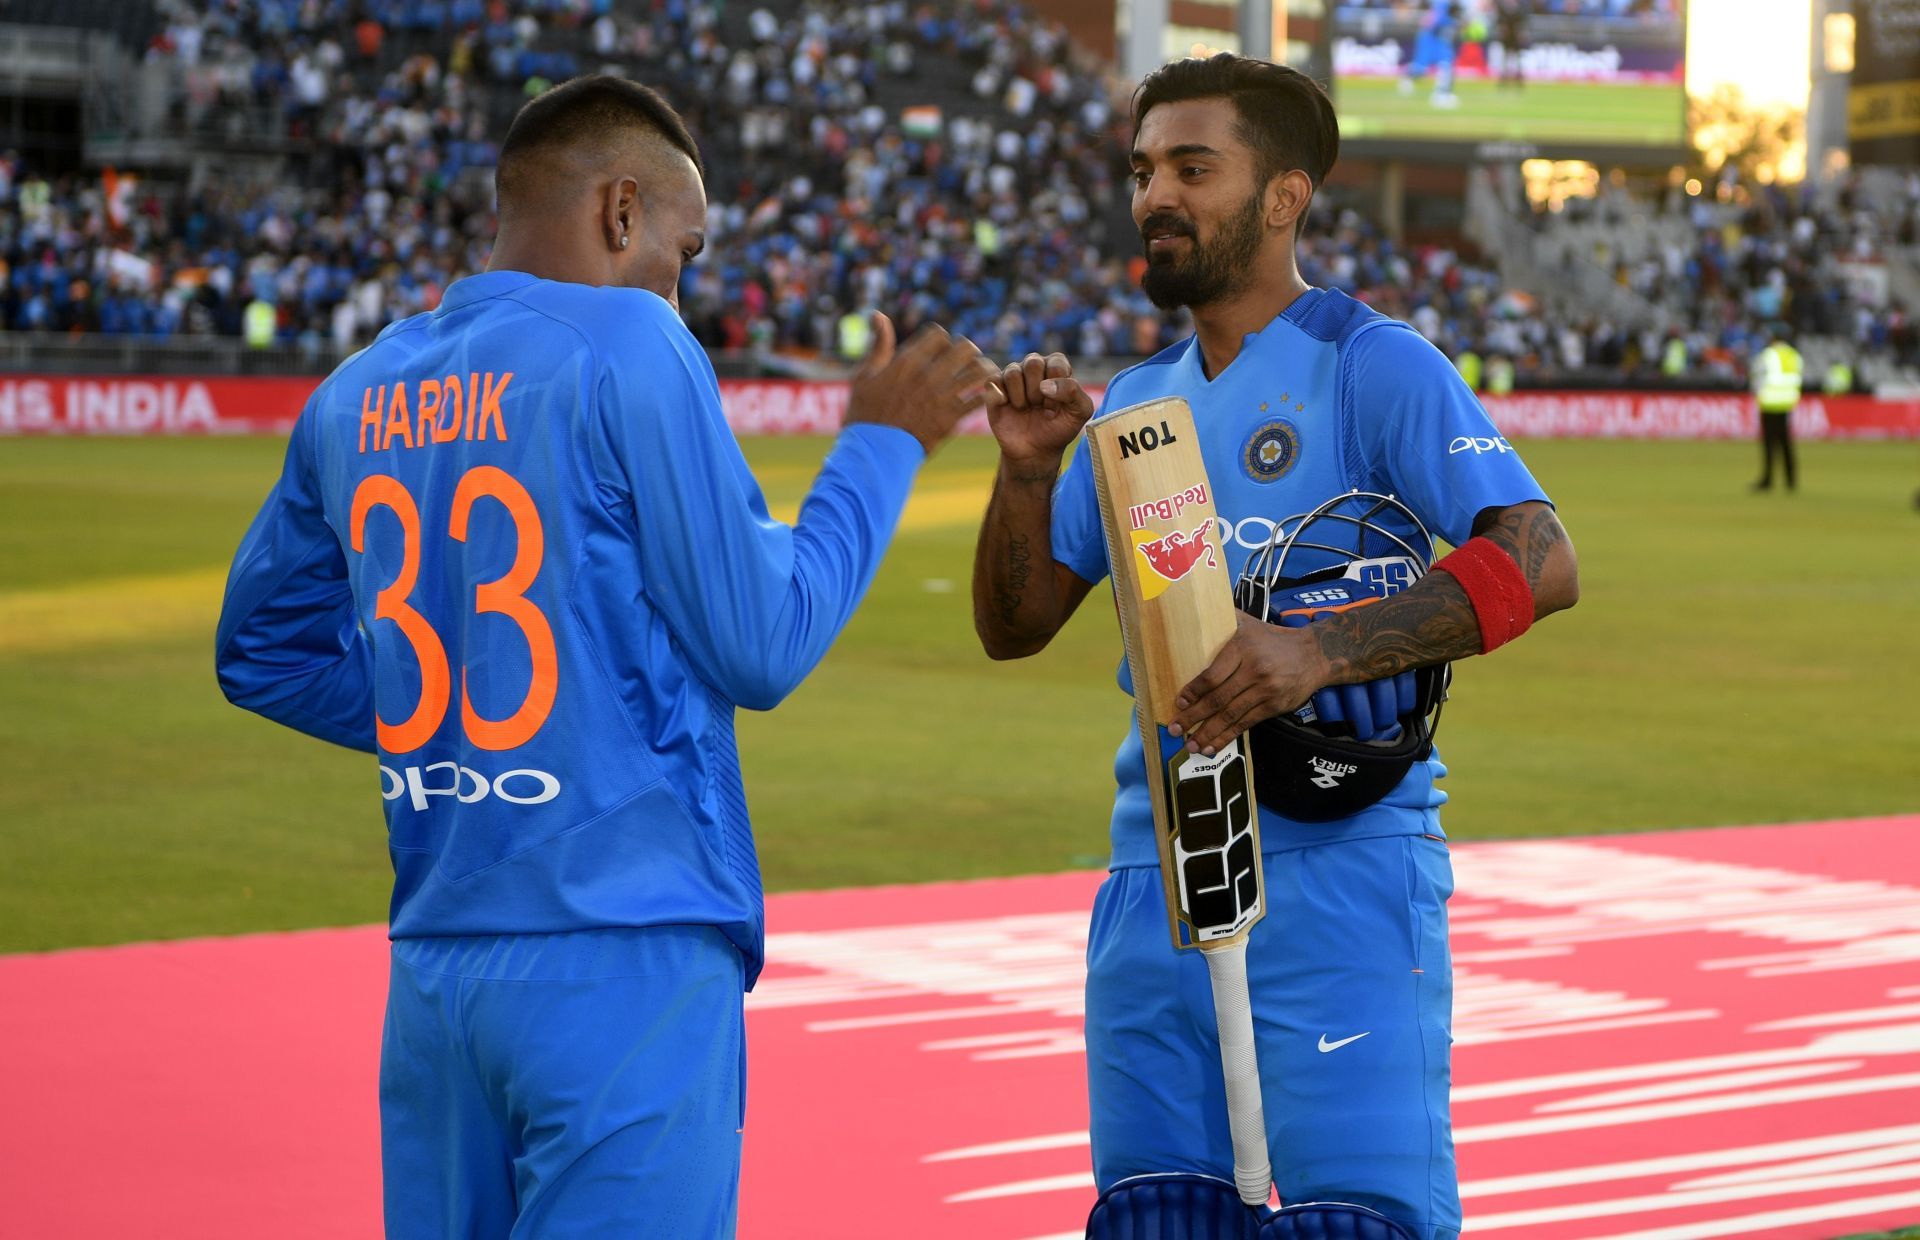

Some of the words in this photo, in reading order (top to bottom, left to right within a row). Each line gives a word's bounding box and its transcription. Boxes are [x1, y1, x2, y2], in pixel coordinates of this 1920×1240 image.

[66, 380, 220, 430] INDIA
[359, 372, 513, 453] HARDIK
[1118, 420, 1177, 459] TON
[1130, 498, 1174, 529] Bull
[350, 465, 558, 754] 33
[1299, 588, 1350, 604] SS
[1307, 755, 1358, 775] SHREY
